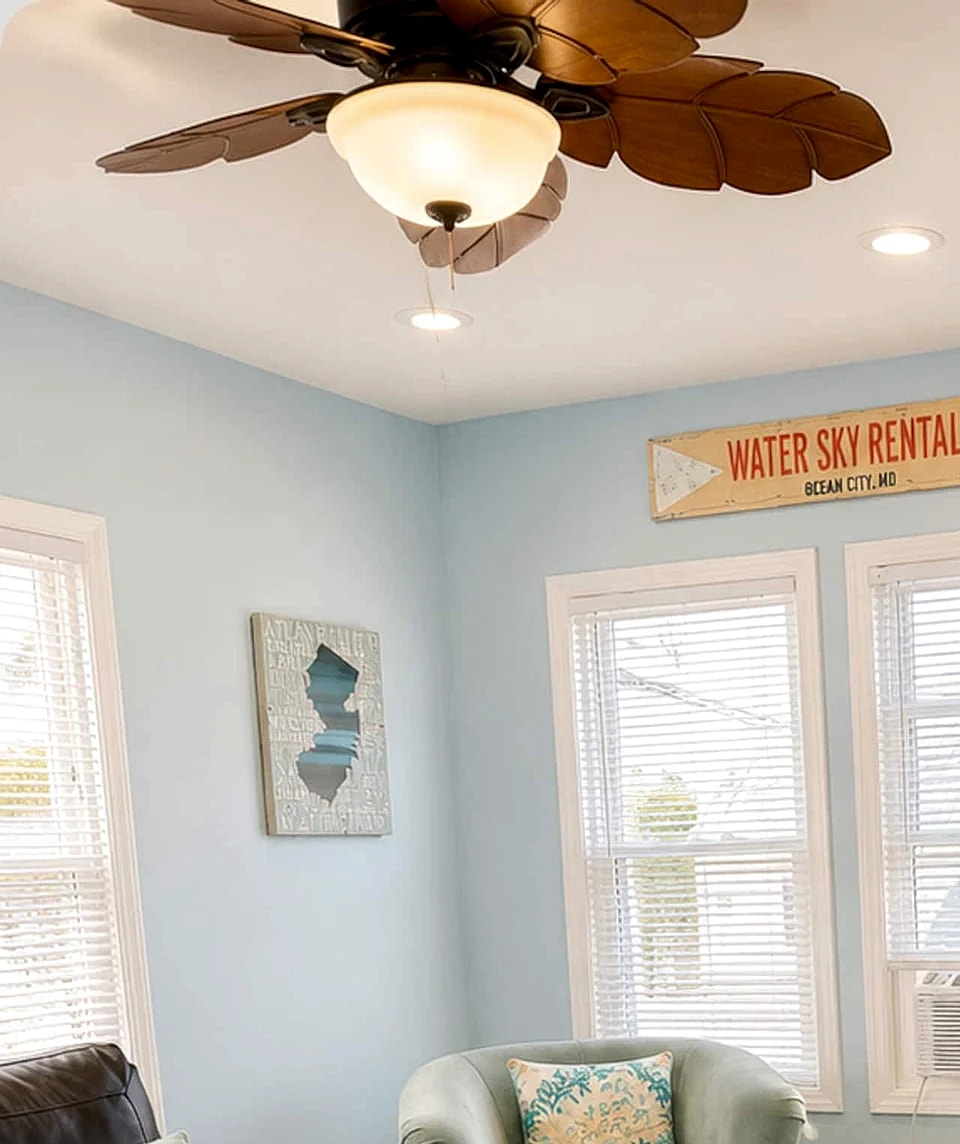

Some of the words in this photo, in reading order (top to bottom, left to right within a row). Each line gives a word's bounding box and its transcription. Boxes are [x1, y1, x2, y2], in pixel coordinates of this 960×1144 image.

[727, 431, 809, 482] WATER
[816, 424, 861, 472] SKY
[879, 471, 896, 487] MD
